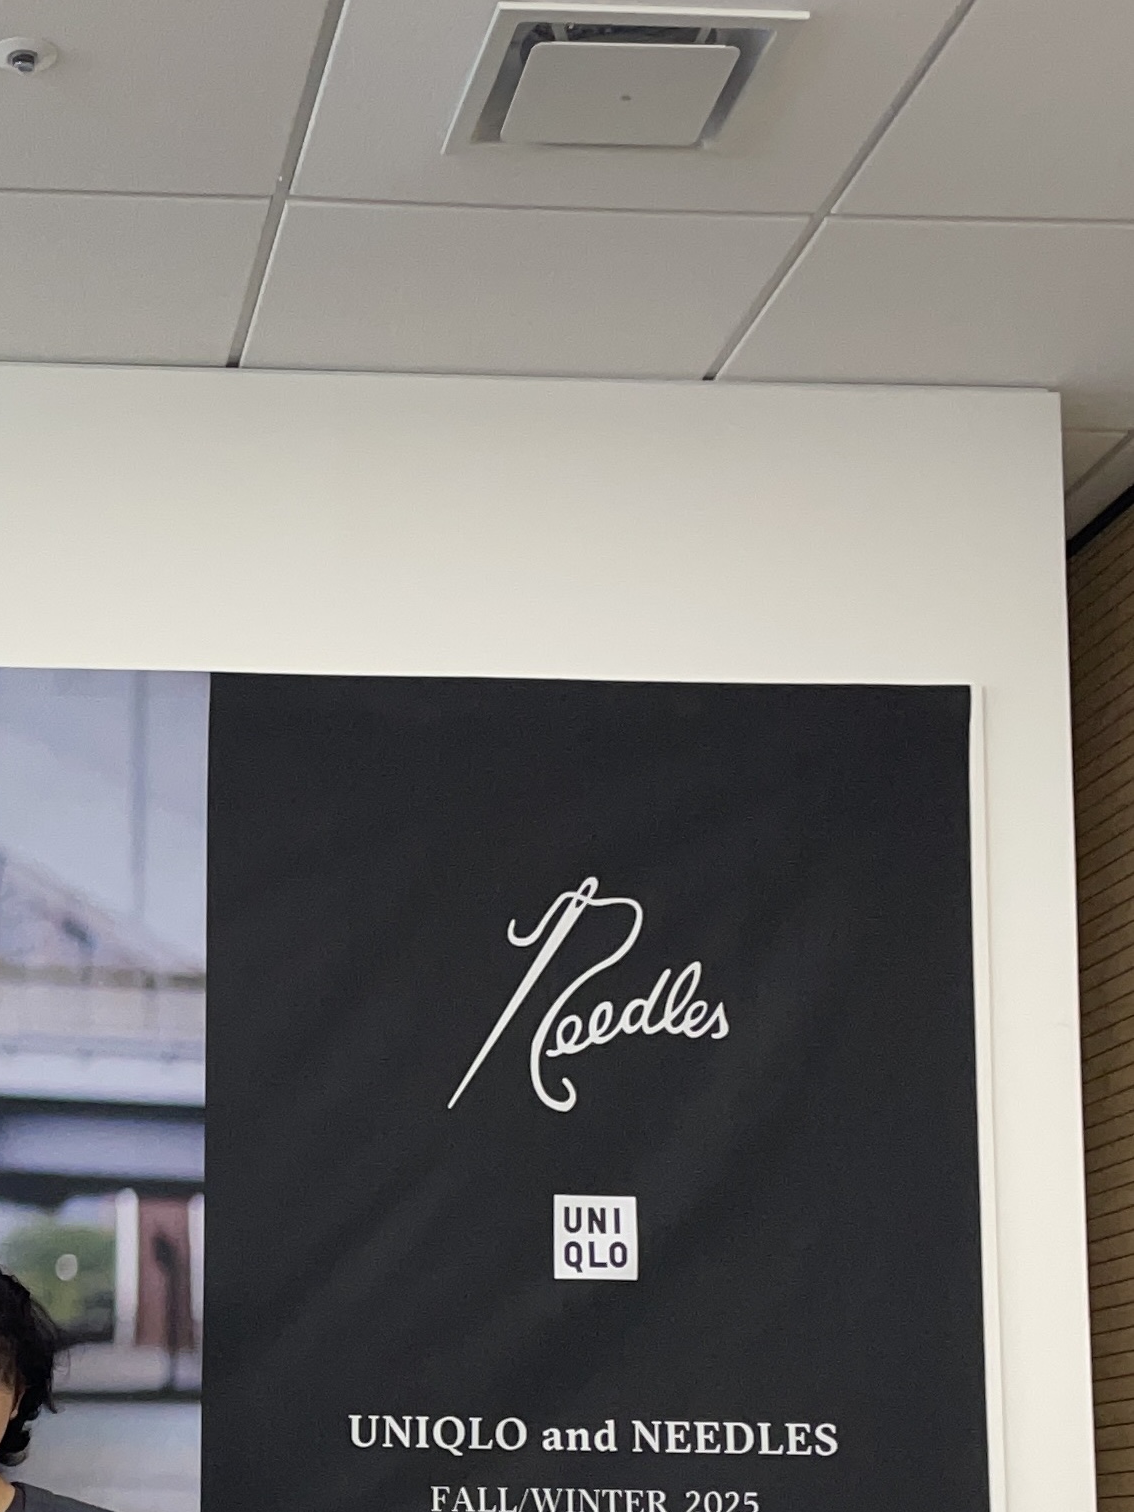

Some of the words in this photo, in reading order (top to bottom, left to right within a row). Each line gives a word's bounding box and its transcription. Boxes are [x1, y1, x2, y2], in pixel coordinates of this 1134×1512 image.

[448, 877, 729, 1112] Needles
[563, 1206, 621, 1234] UNI
[563, 1241, 628, 1273] QLO
[348, 1414, 527, 1456] UNIQLO
[543, 1419, 618, 1452] and
[631, 1420, 839, 1457] NEEDLES
